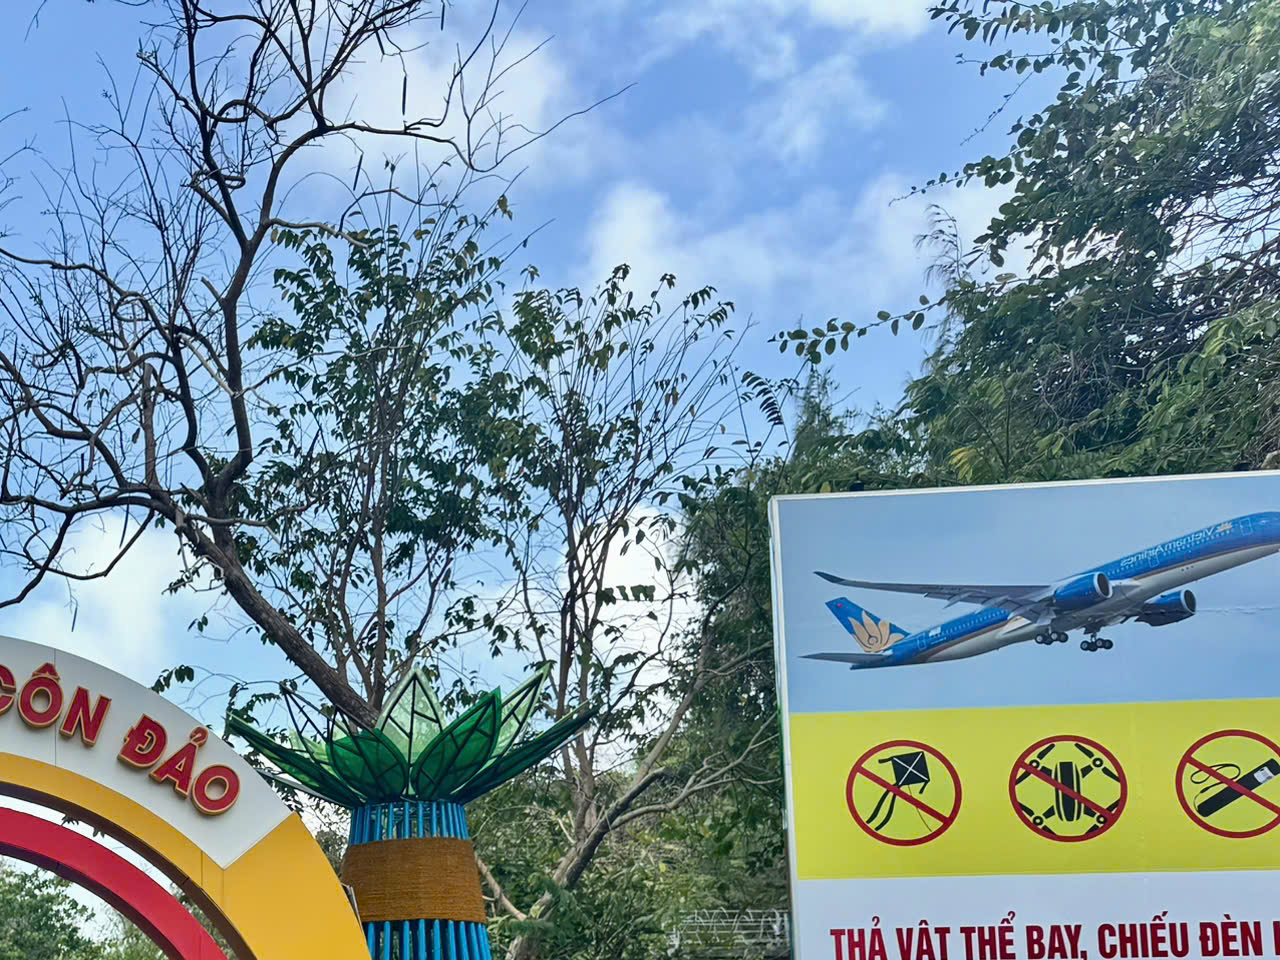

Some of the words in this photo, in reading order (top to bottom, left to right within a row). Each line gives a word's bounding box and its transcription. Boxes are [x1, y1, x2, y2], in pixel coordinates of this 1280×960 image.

[117, 713, 241, 816] ĐẢO
[960, 911, 1016, 960] THỂ
[1098, 911, 1189, 959] CHIẾU
[1199, 914, 1263, 957] ĐÈN
